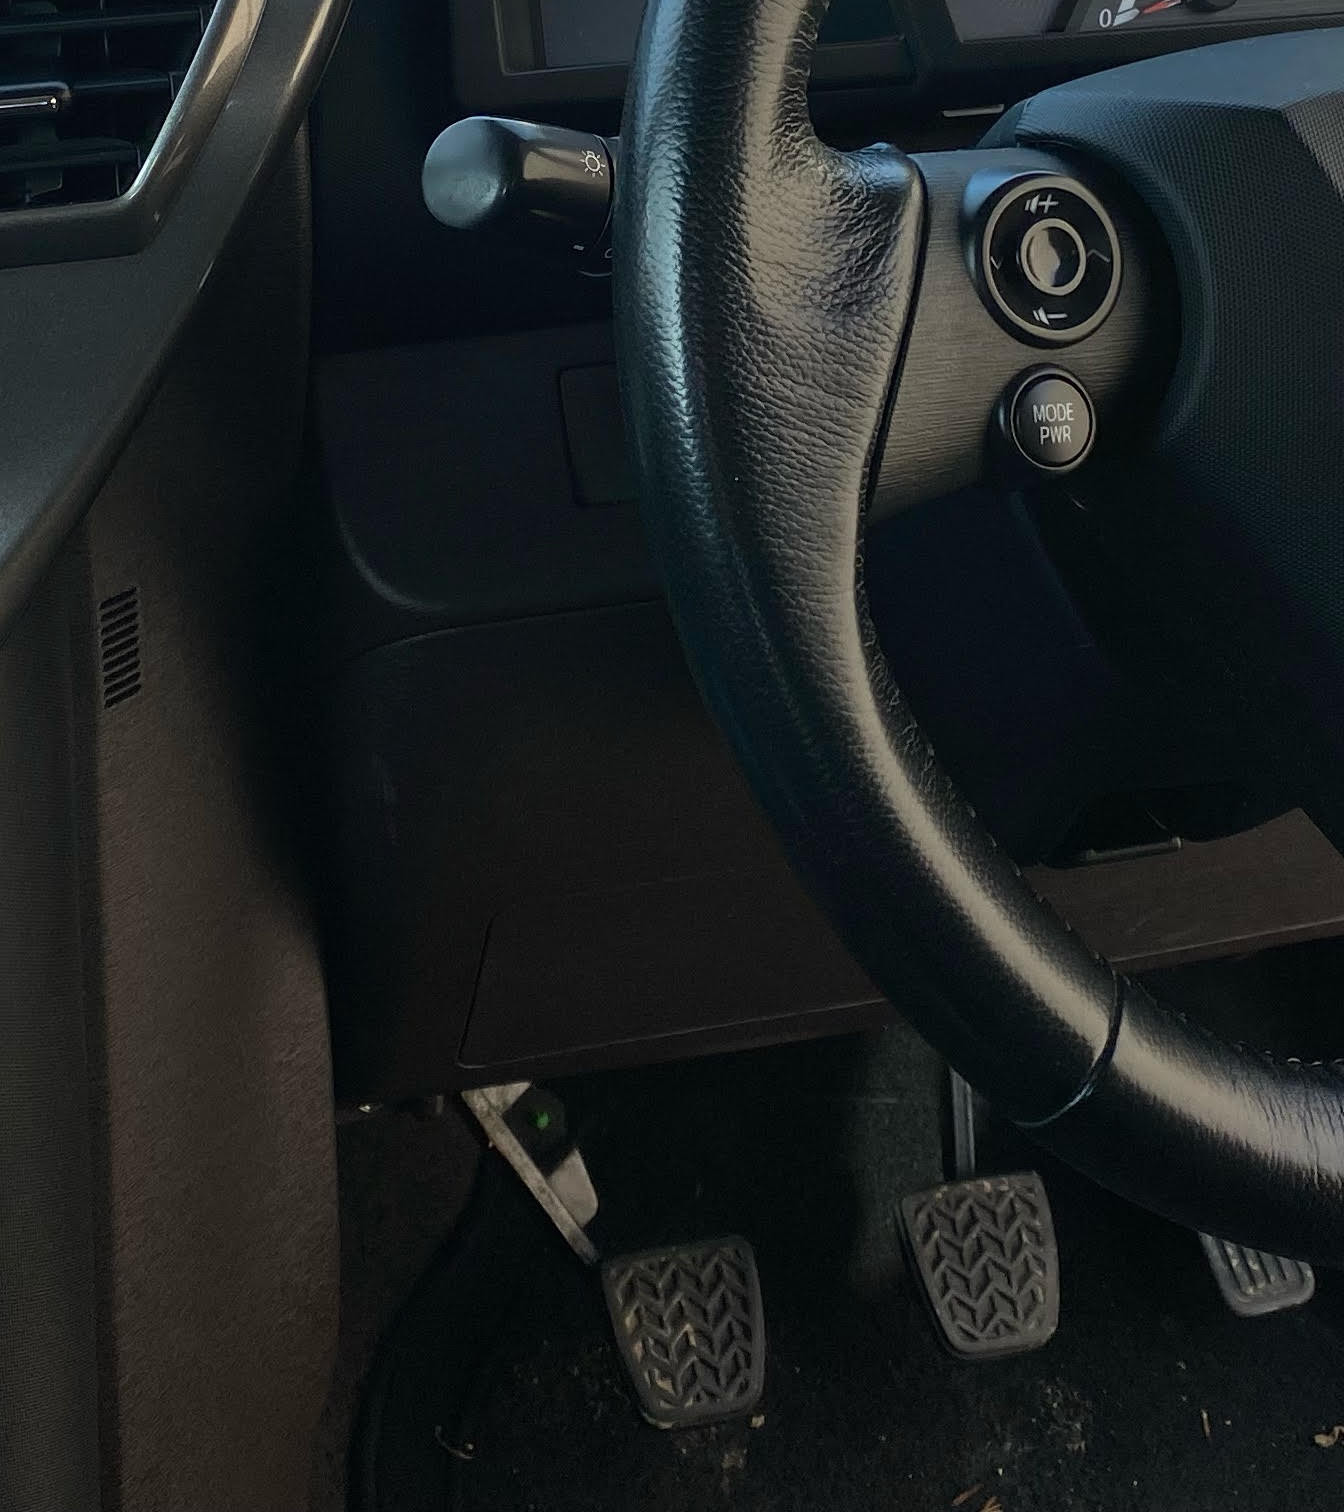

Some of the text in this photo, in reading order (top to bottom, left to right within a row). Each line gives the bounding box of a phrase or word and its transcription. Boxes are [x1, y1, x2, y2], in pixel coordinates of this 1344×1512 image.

[1099, 9, 1111, 28] 0
[1033, 402, 1074, 423] MODE
[1039, 424, 1072, 444] PWR
